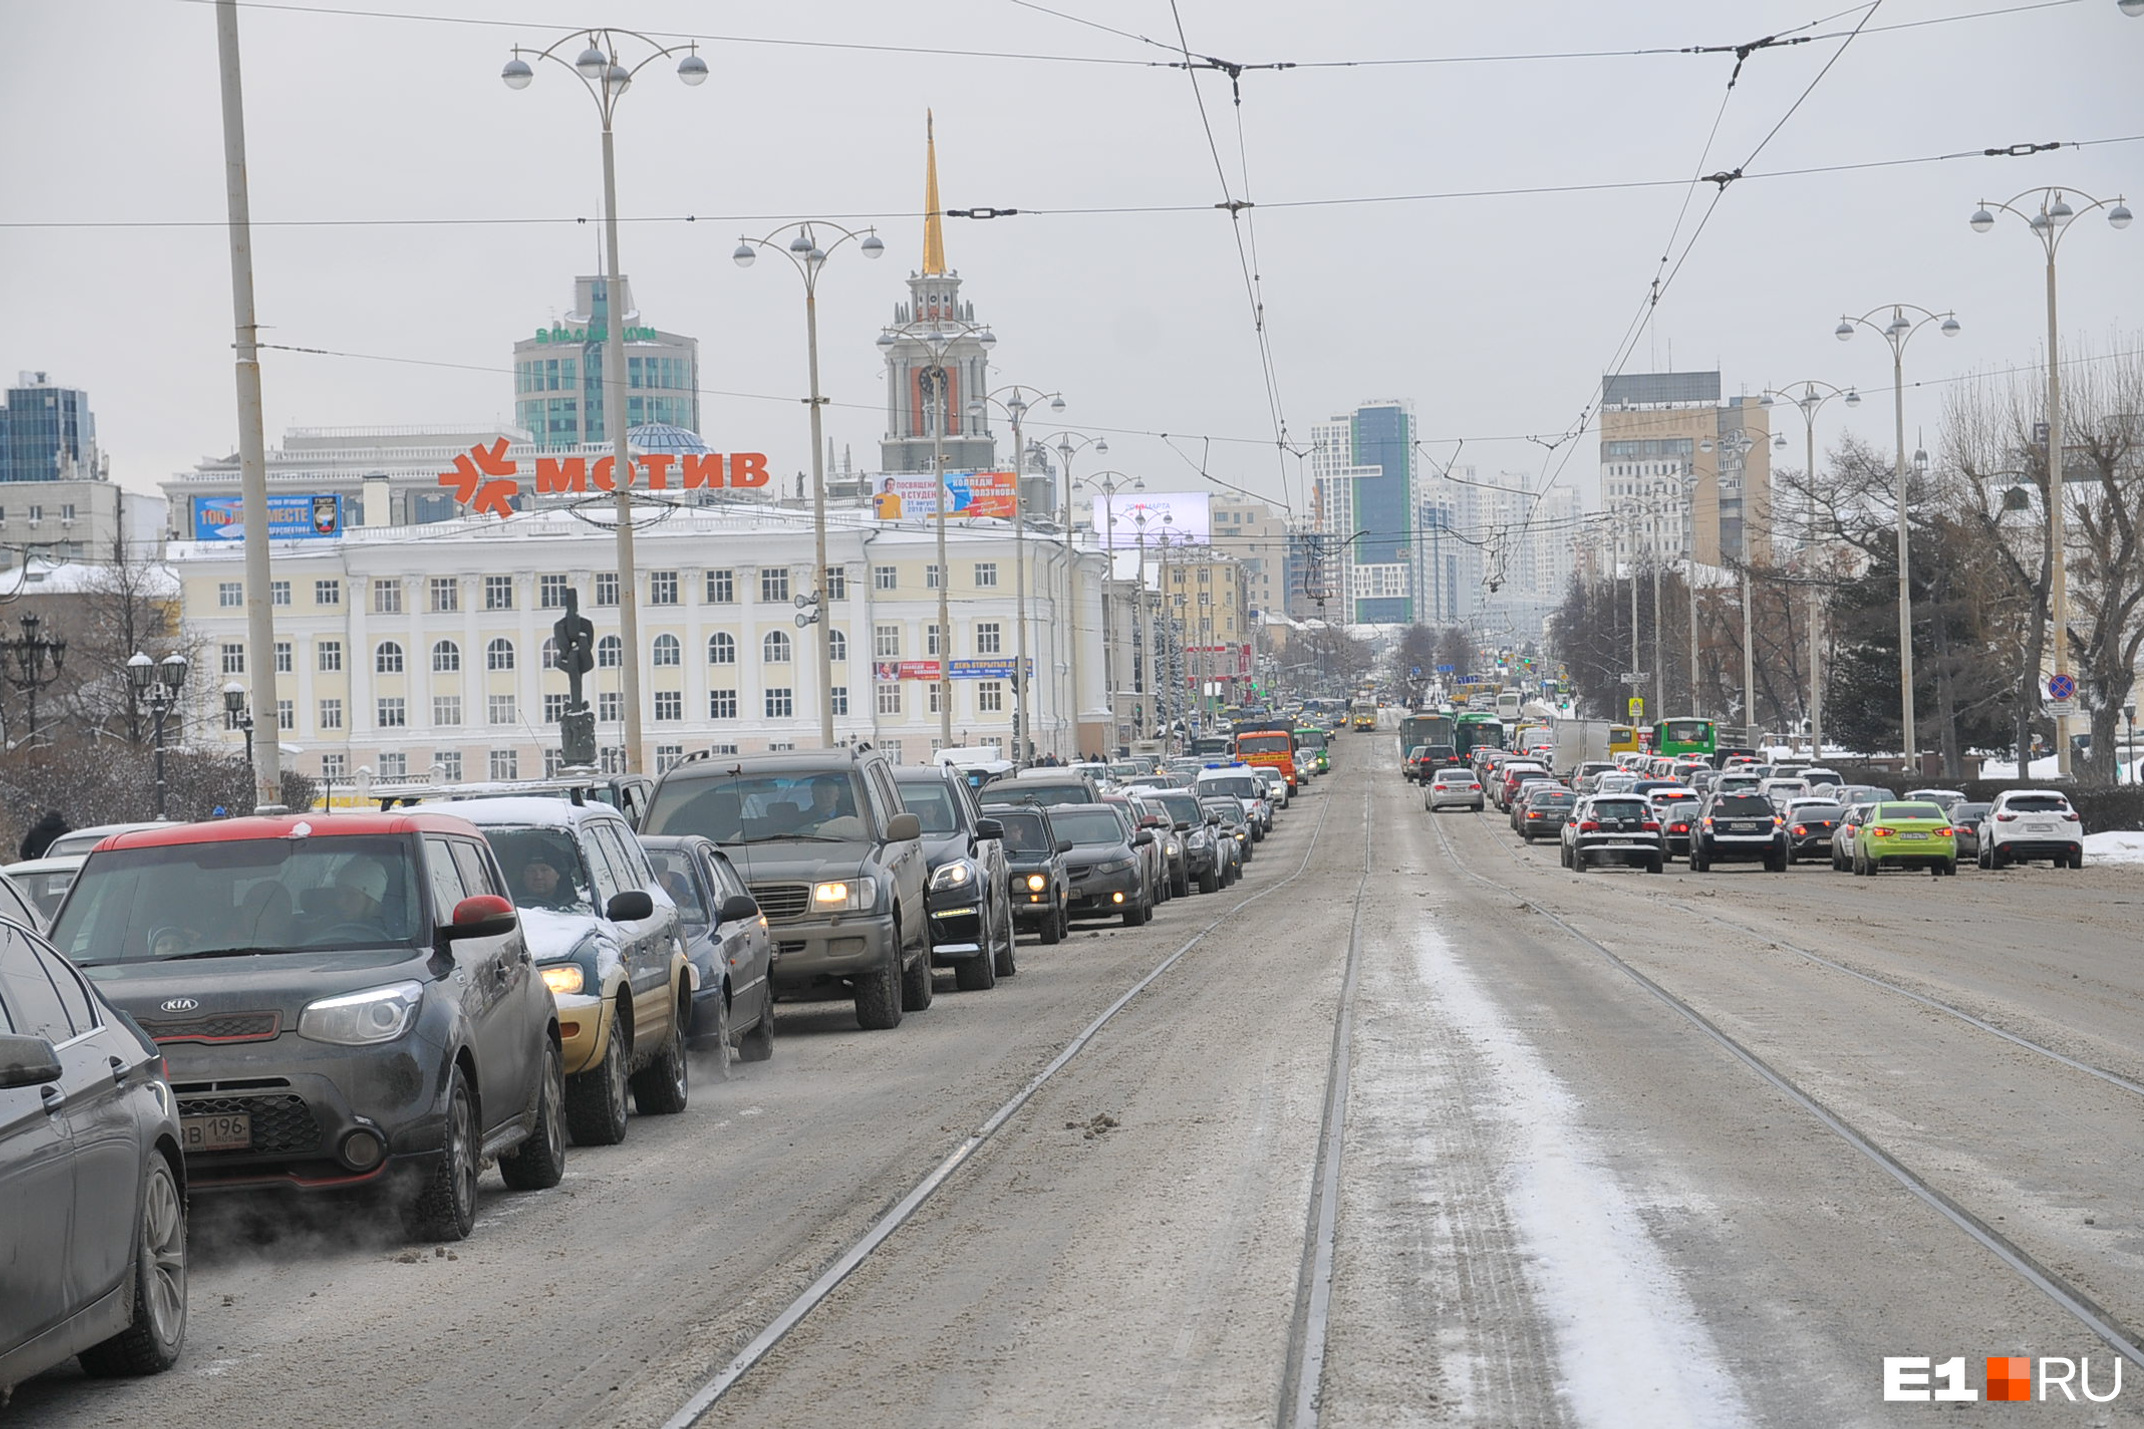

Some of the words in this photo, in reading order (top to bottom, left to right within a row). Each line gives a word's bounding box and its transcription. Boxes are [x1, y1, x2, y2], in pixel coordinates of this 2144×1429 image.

[535, 452, 769, 493] МОТИВ
[167, 1000, 191, 1010] KIA
[207, 1116, 243, 1136] 196
